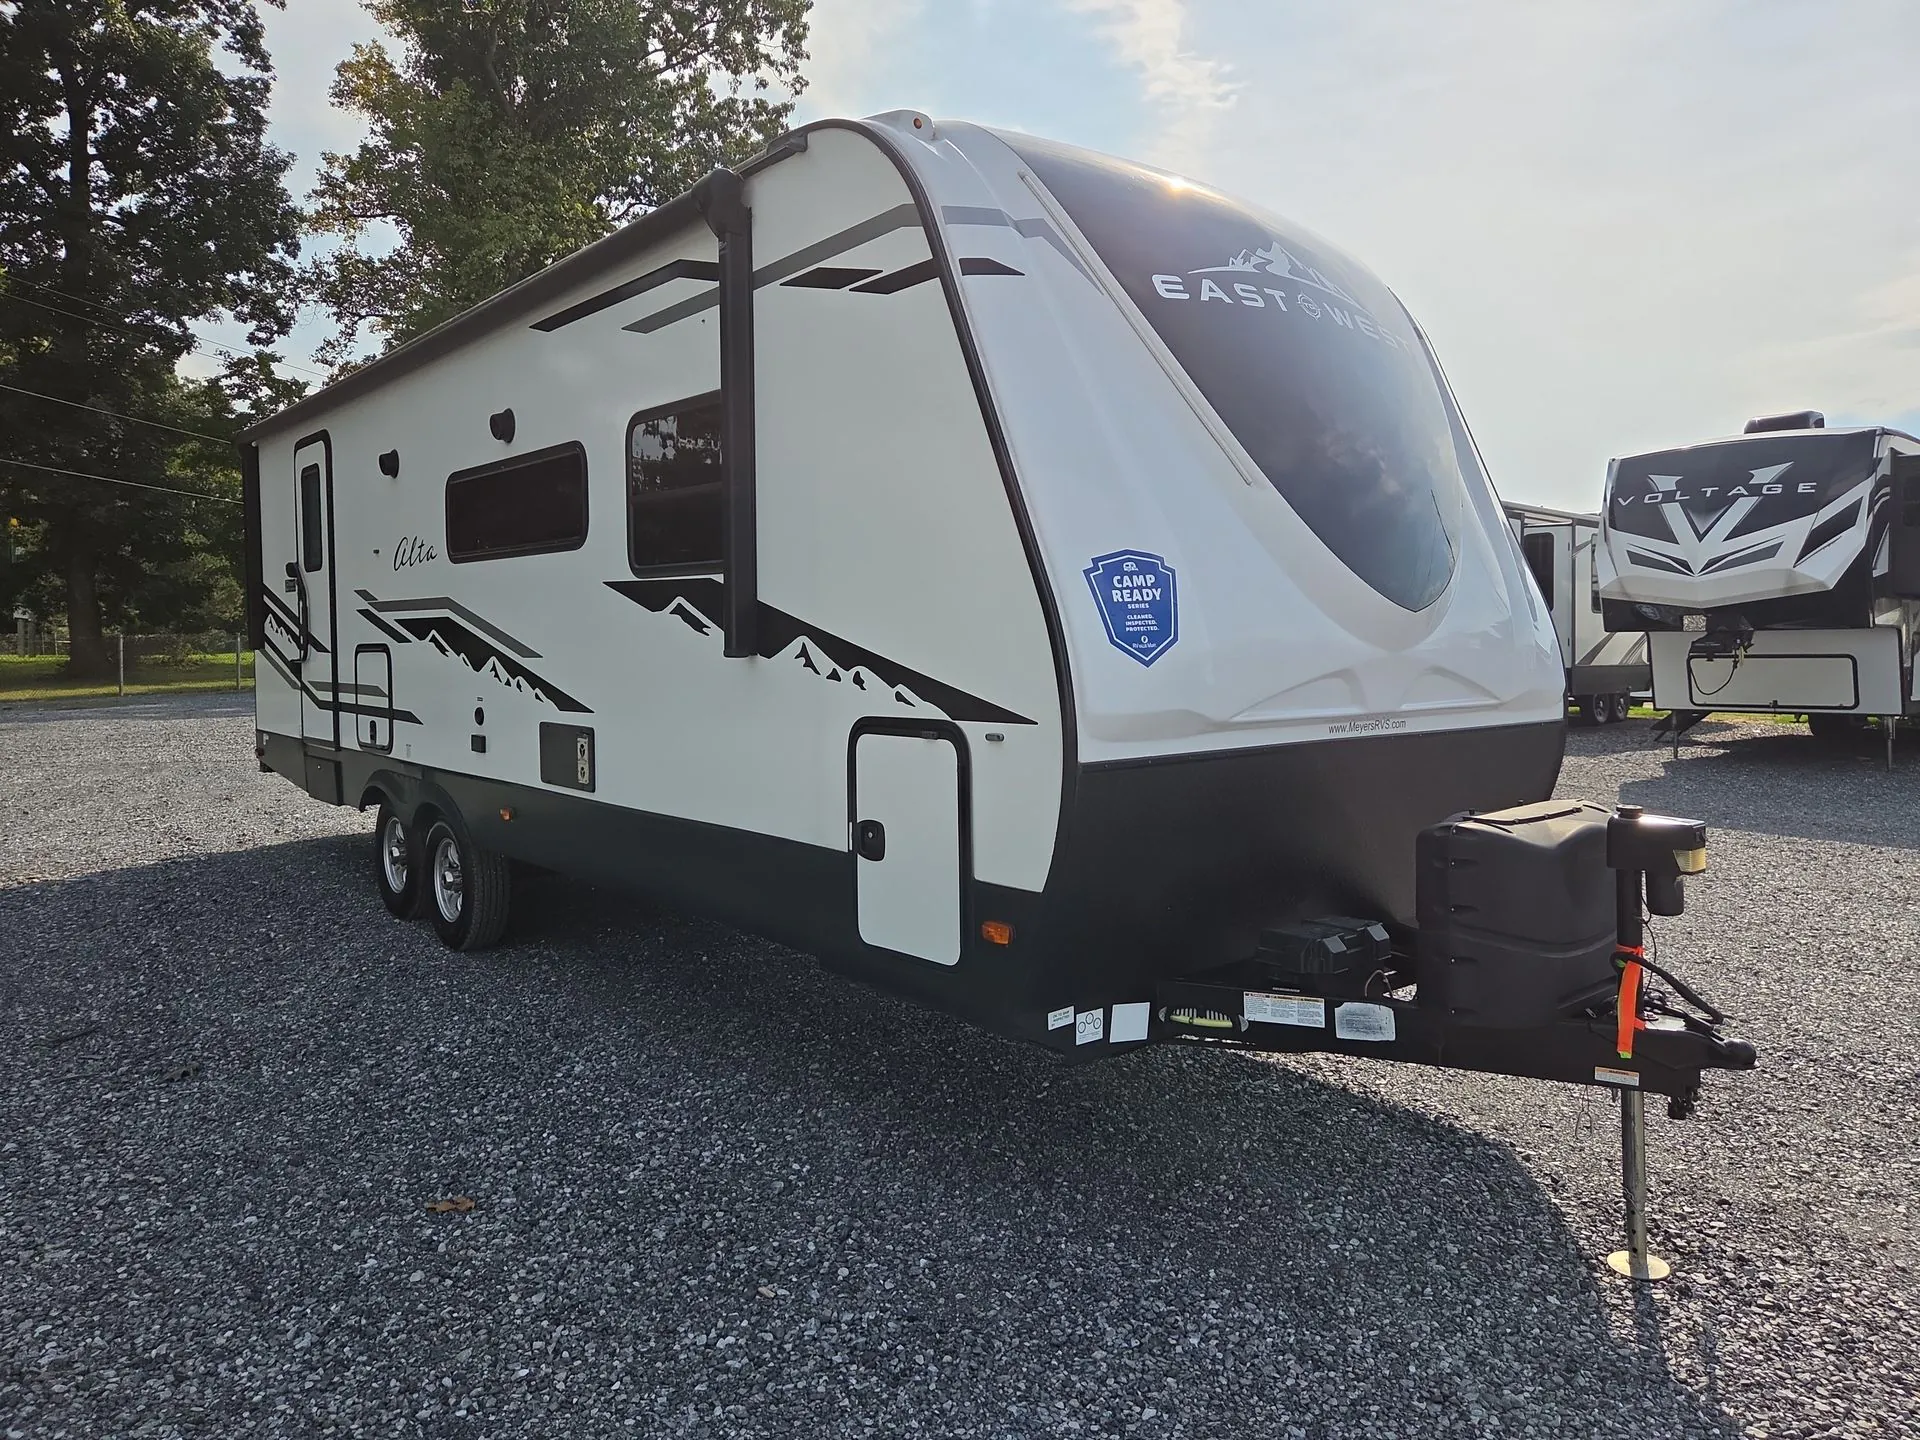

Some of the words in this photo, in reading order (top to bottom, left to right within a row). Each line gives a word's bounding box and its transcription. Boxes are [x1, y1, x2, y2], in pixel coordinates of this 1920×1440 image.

[1151, 274, 1289, 312] EAST
[1322, 302, 1410, 353] WEST
[1617, 482, 1817, 506] VOLTAGE
[393, 535, 438, 571] Alta
[1113, 575, 1155, 588] CAMP
[1112, 587, 1162, 602] READY
[1327, 719, 1407, 734] www.MeyersRVS.com
